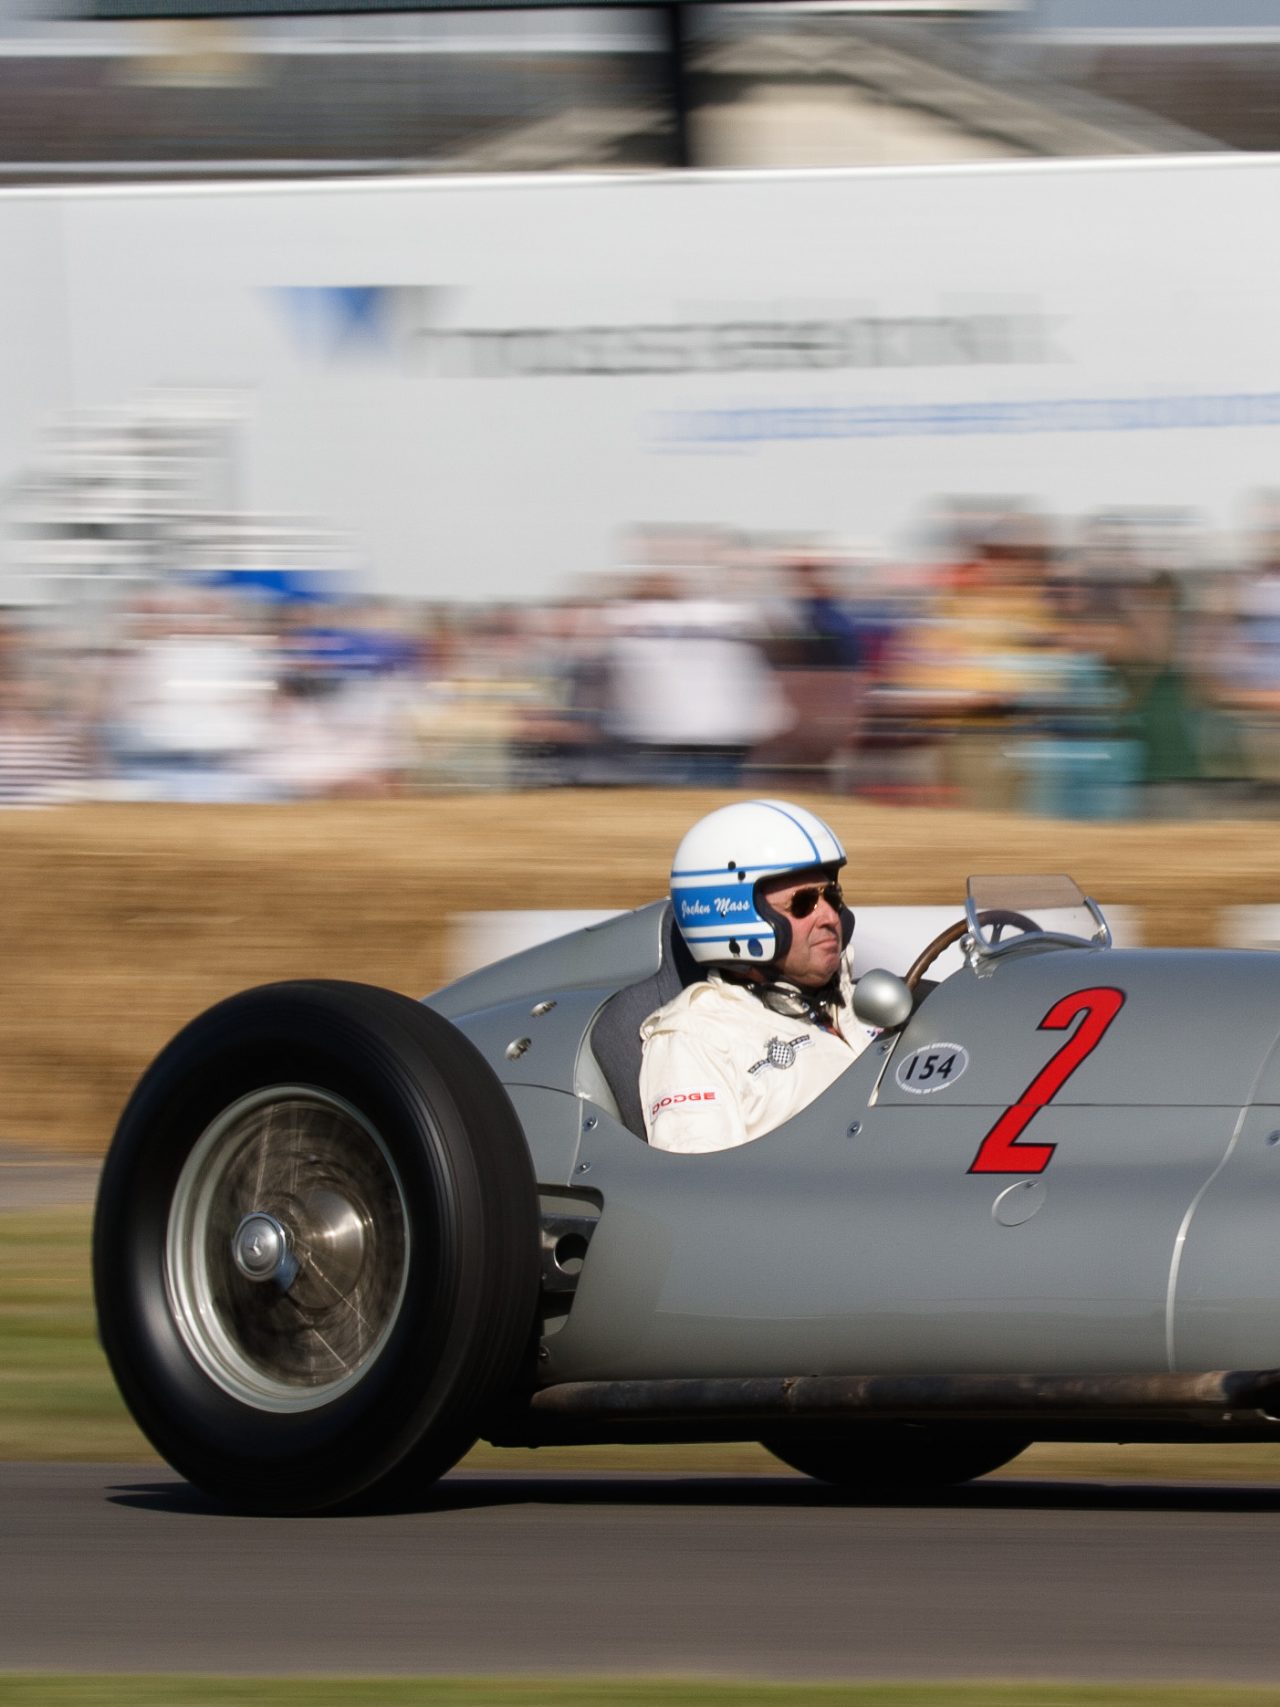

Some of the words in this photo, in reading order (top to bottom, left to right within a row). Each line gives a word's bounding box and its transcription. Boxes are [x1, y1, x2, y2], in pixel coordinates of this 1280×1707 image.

[681, 899, 711, 918] Jochen
[714, 897, 750, 916] Mass
[905, 1053, 957, 1081] 154
[966, 986, 1127, 1174] 2
[652, 1091, 716, 1116] DODGE
